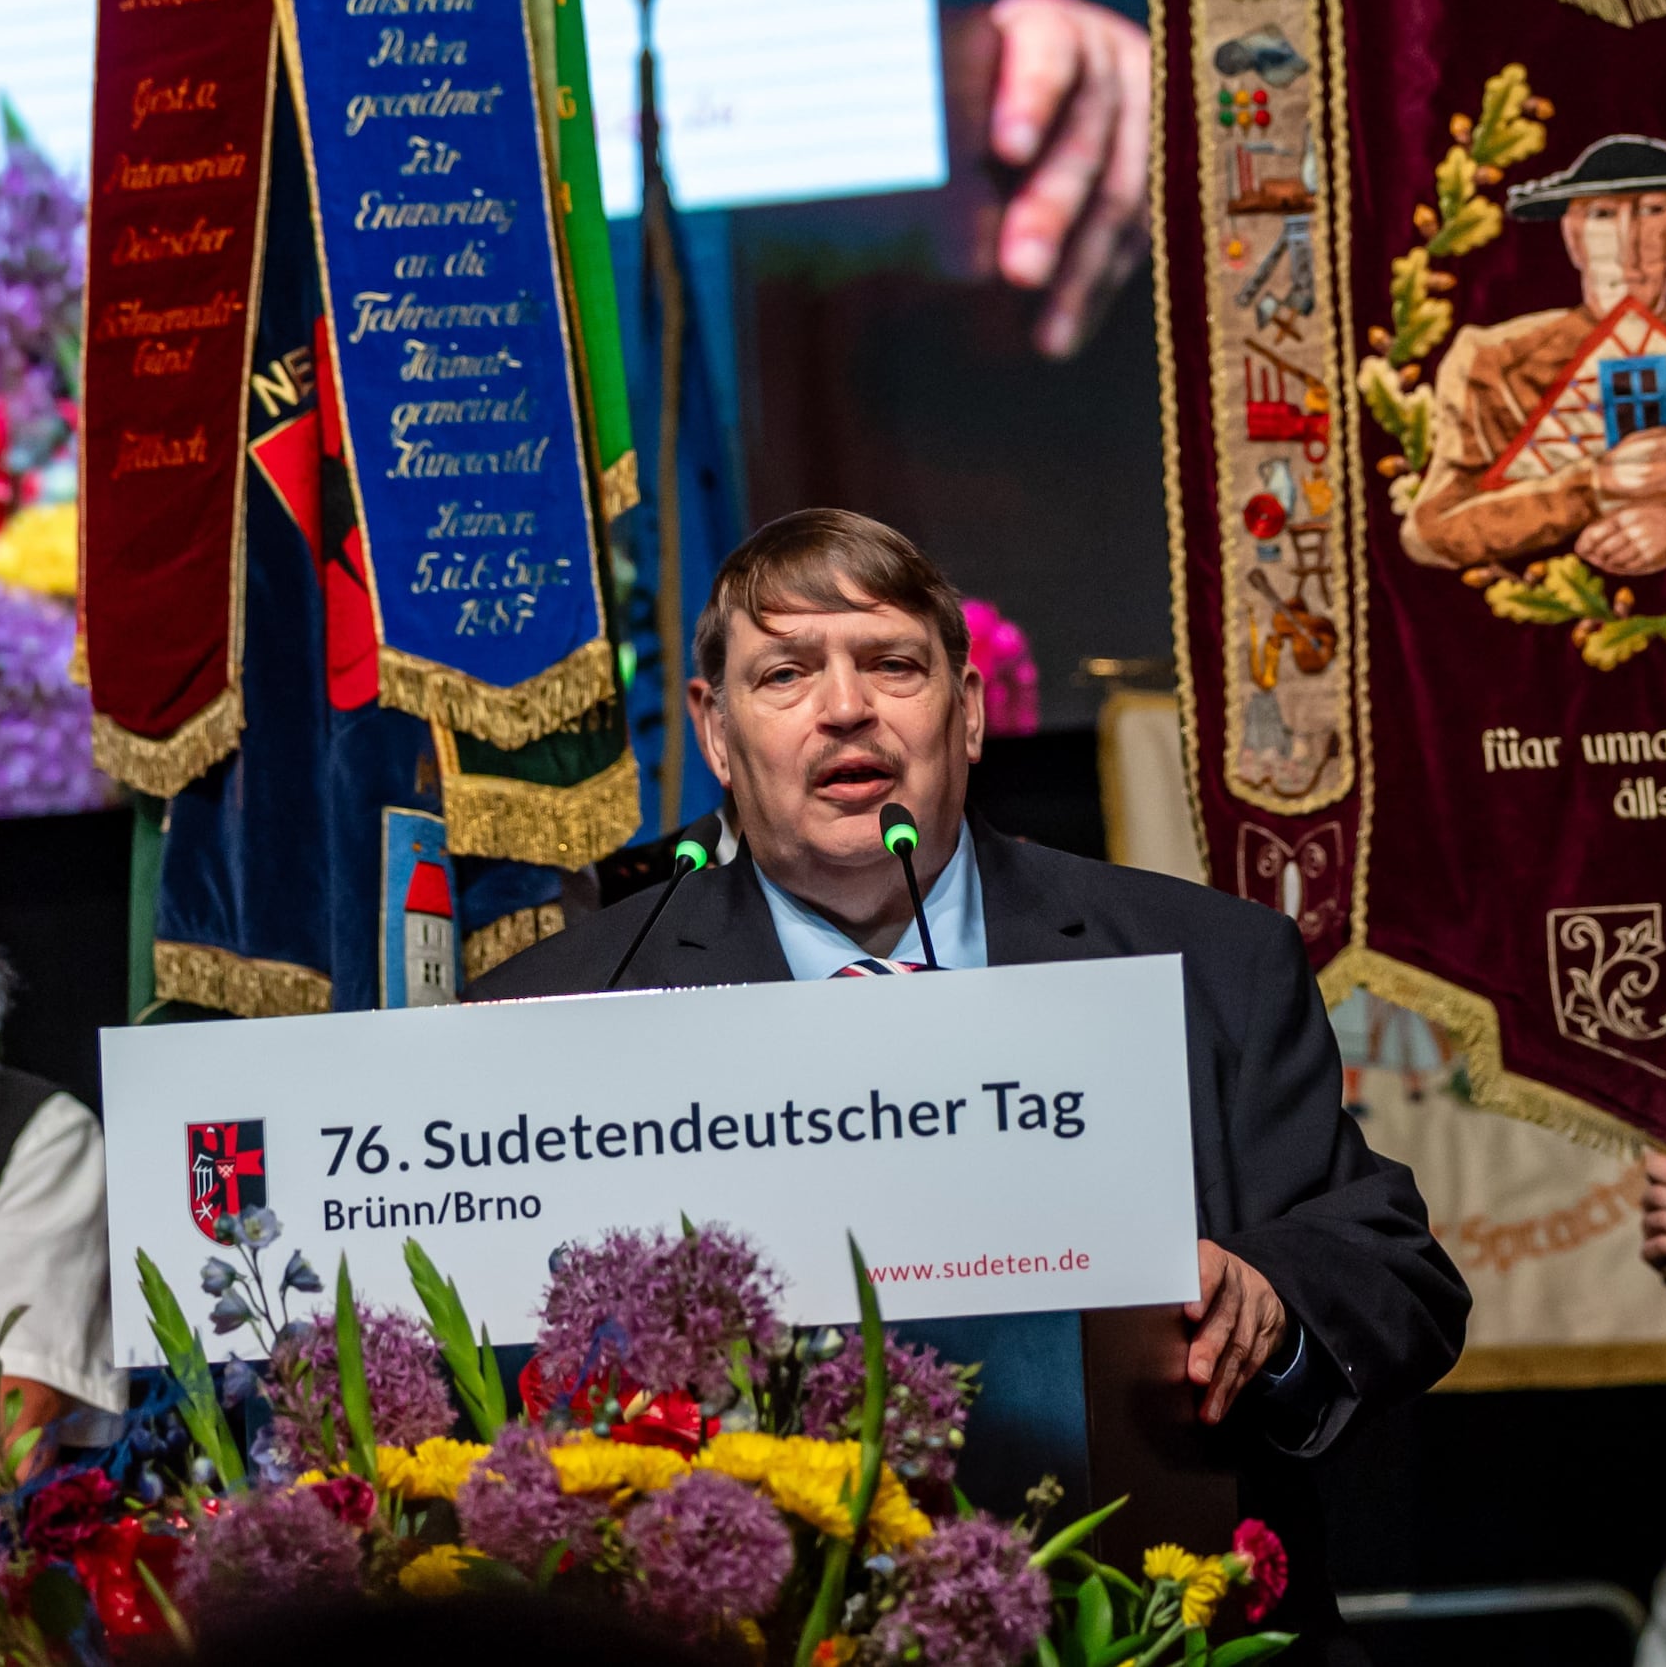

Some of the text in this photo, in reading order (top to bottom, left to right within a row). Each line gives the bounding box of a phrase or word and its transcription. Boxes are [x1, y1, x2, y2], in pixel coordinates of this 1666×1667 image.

[1481, 726, 1562, 774] füar
[321, 1079, 1086, 1180] 76. Sudetendeutscher Tag
[323, 1187, 543, 1234] Brünn/Brno
[865, 1248, 1091, 1285] www.sudeten.de
